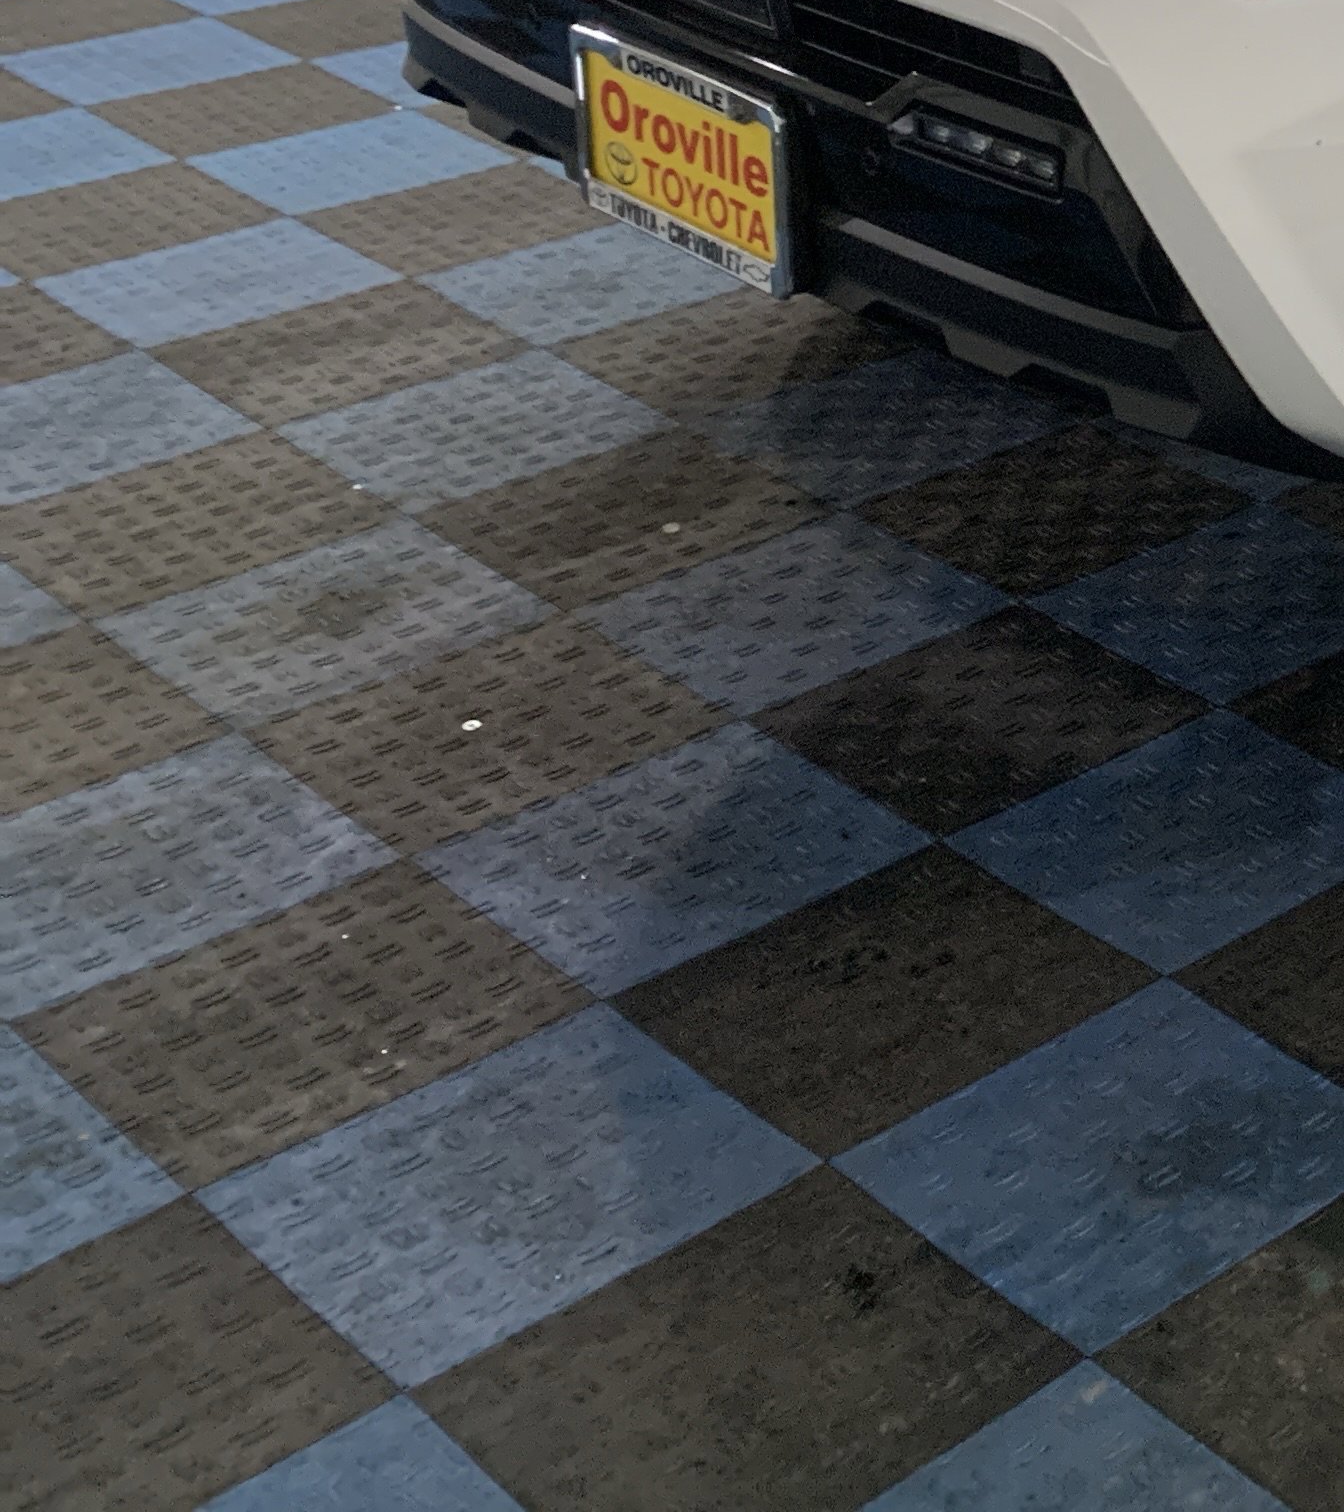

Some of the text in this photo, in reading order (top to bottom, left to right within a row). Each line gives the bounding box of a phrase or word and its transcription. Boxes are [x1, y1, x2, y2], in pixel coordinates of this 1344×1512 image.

[626, 54, 725, 113] OROVILLE
[600, 79, 769, 197] Oroville
[610, 193, 742, 275] TOYOTA CHEVROLET
[640, 157, 770, 253] TOYOTA
